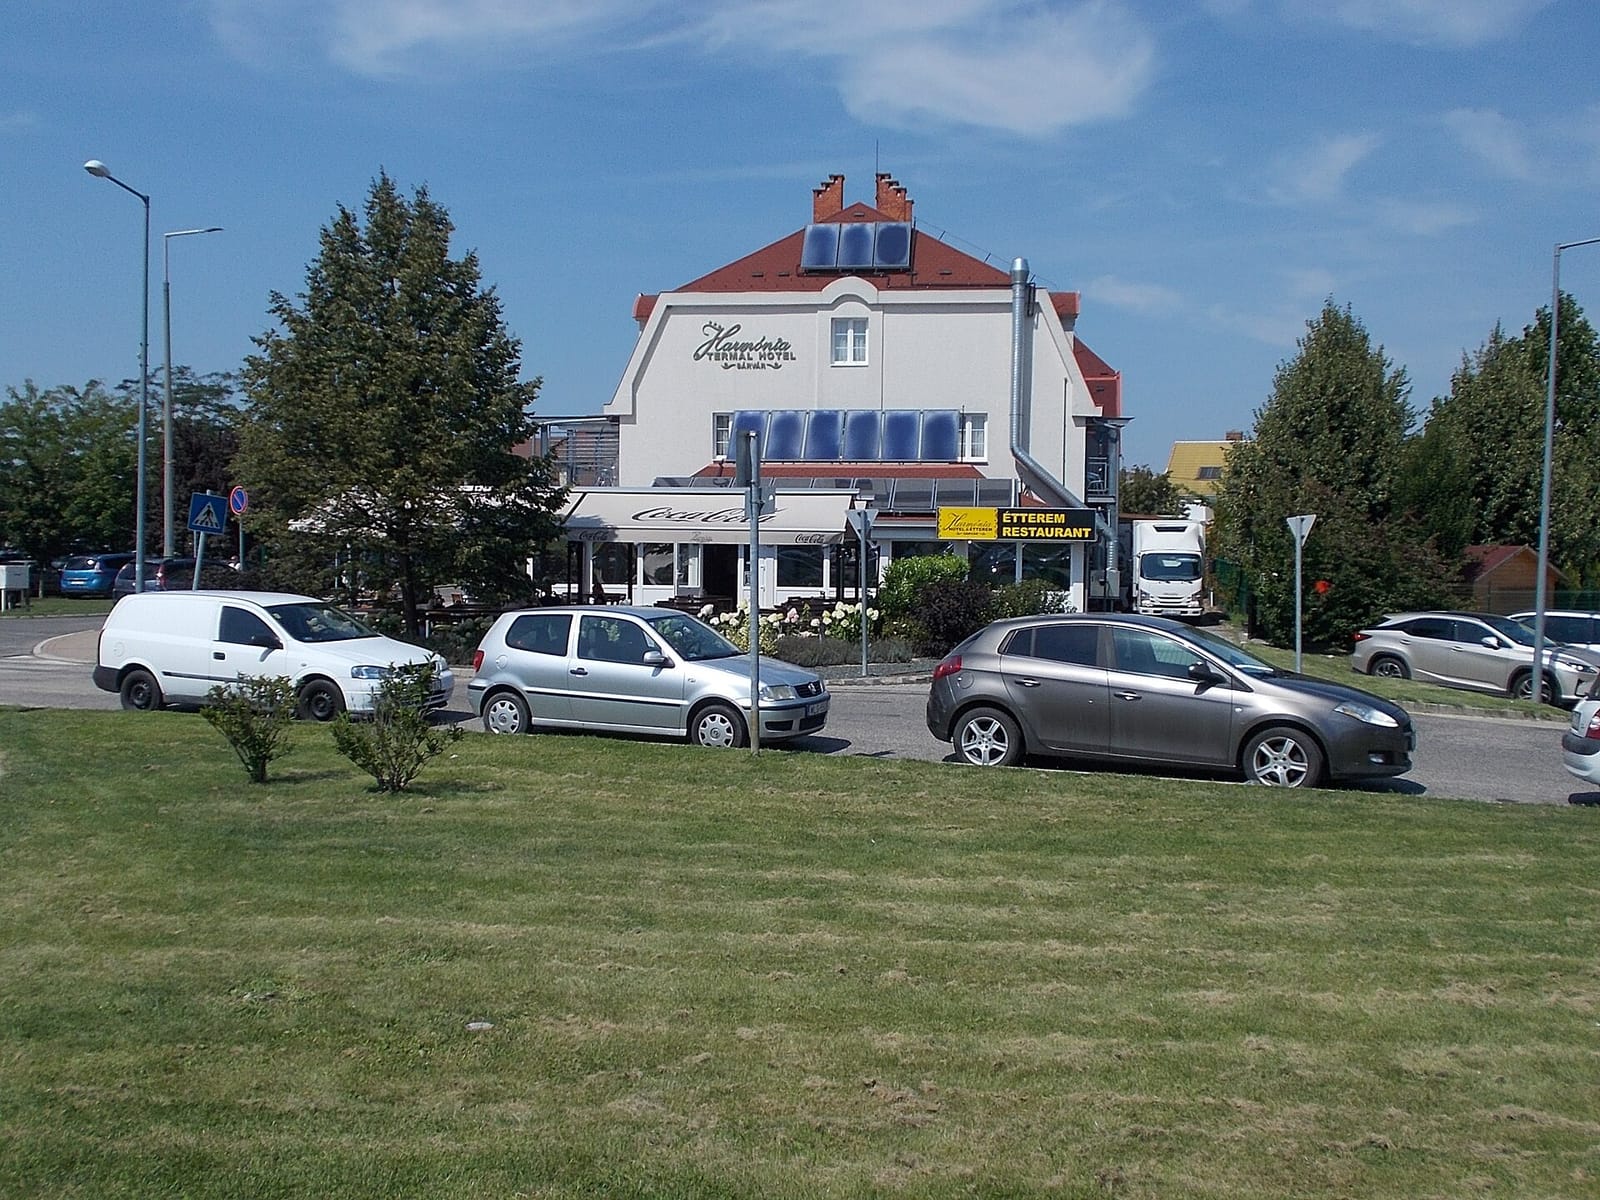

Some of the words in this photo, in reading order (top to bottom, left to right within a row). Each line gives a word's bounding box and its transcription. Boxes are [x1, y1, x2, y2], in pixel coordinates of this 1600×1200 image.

[693, 323, 792, 361] Harmónia
[707, 352, 753, 361] TERMAL
[759, 352, 797, 361] HOTEL
[1002, 511, 1065, 524] ÉTTEREM
[1002, 527, 1092, 538] RESTAURANT
